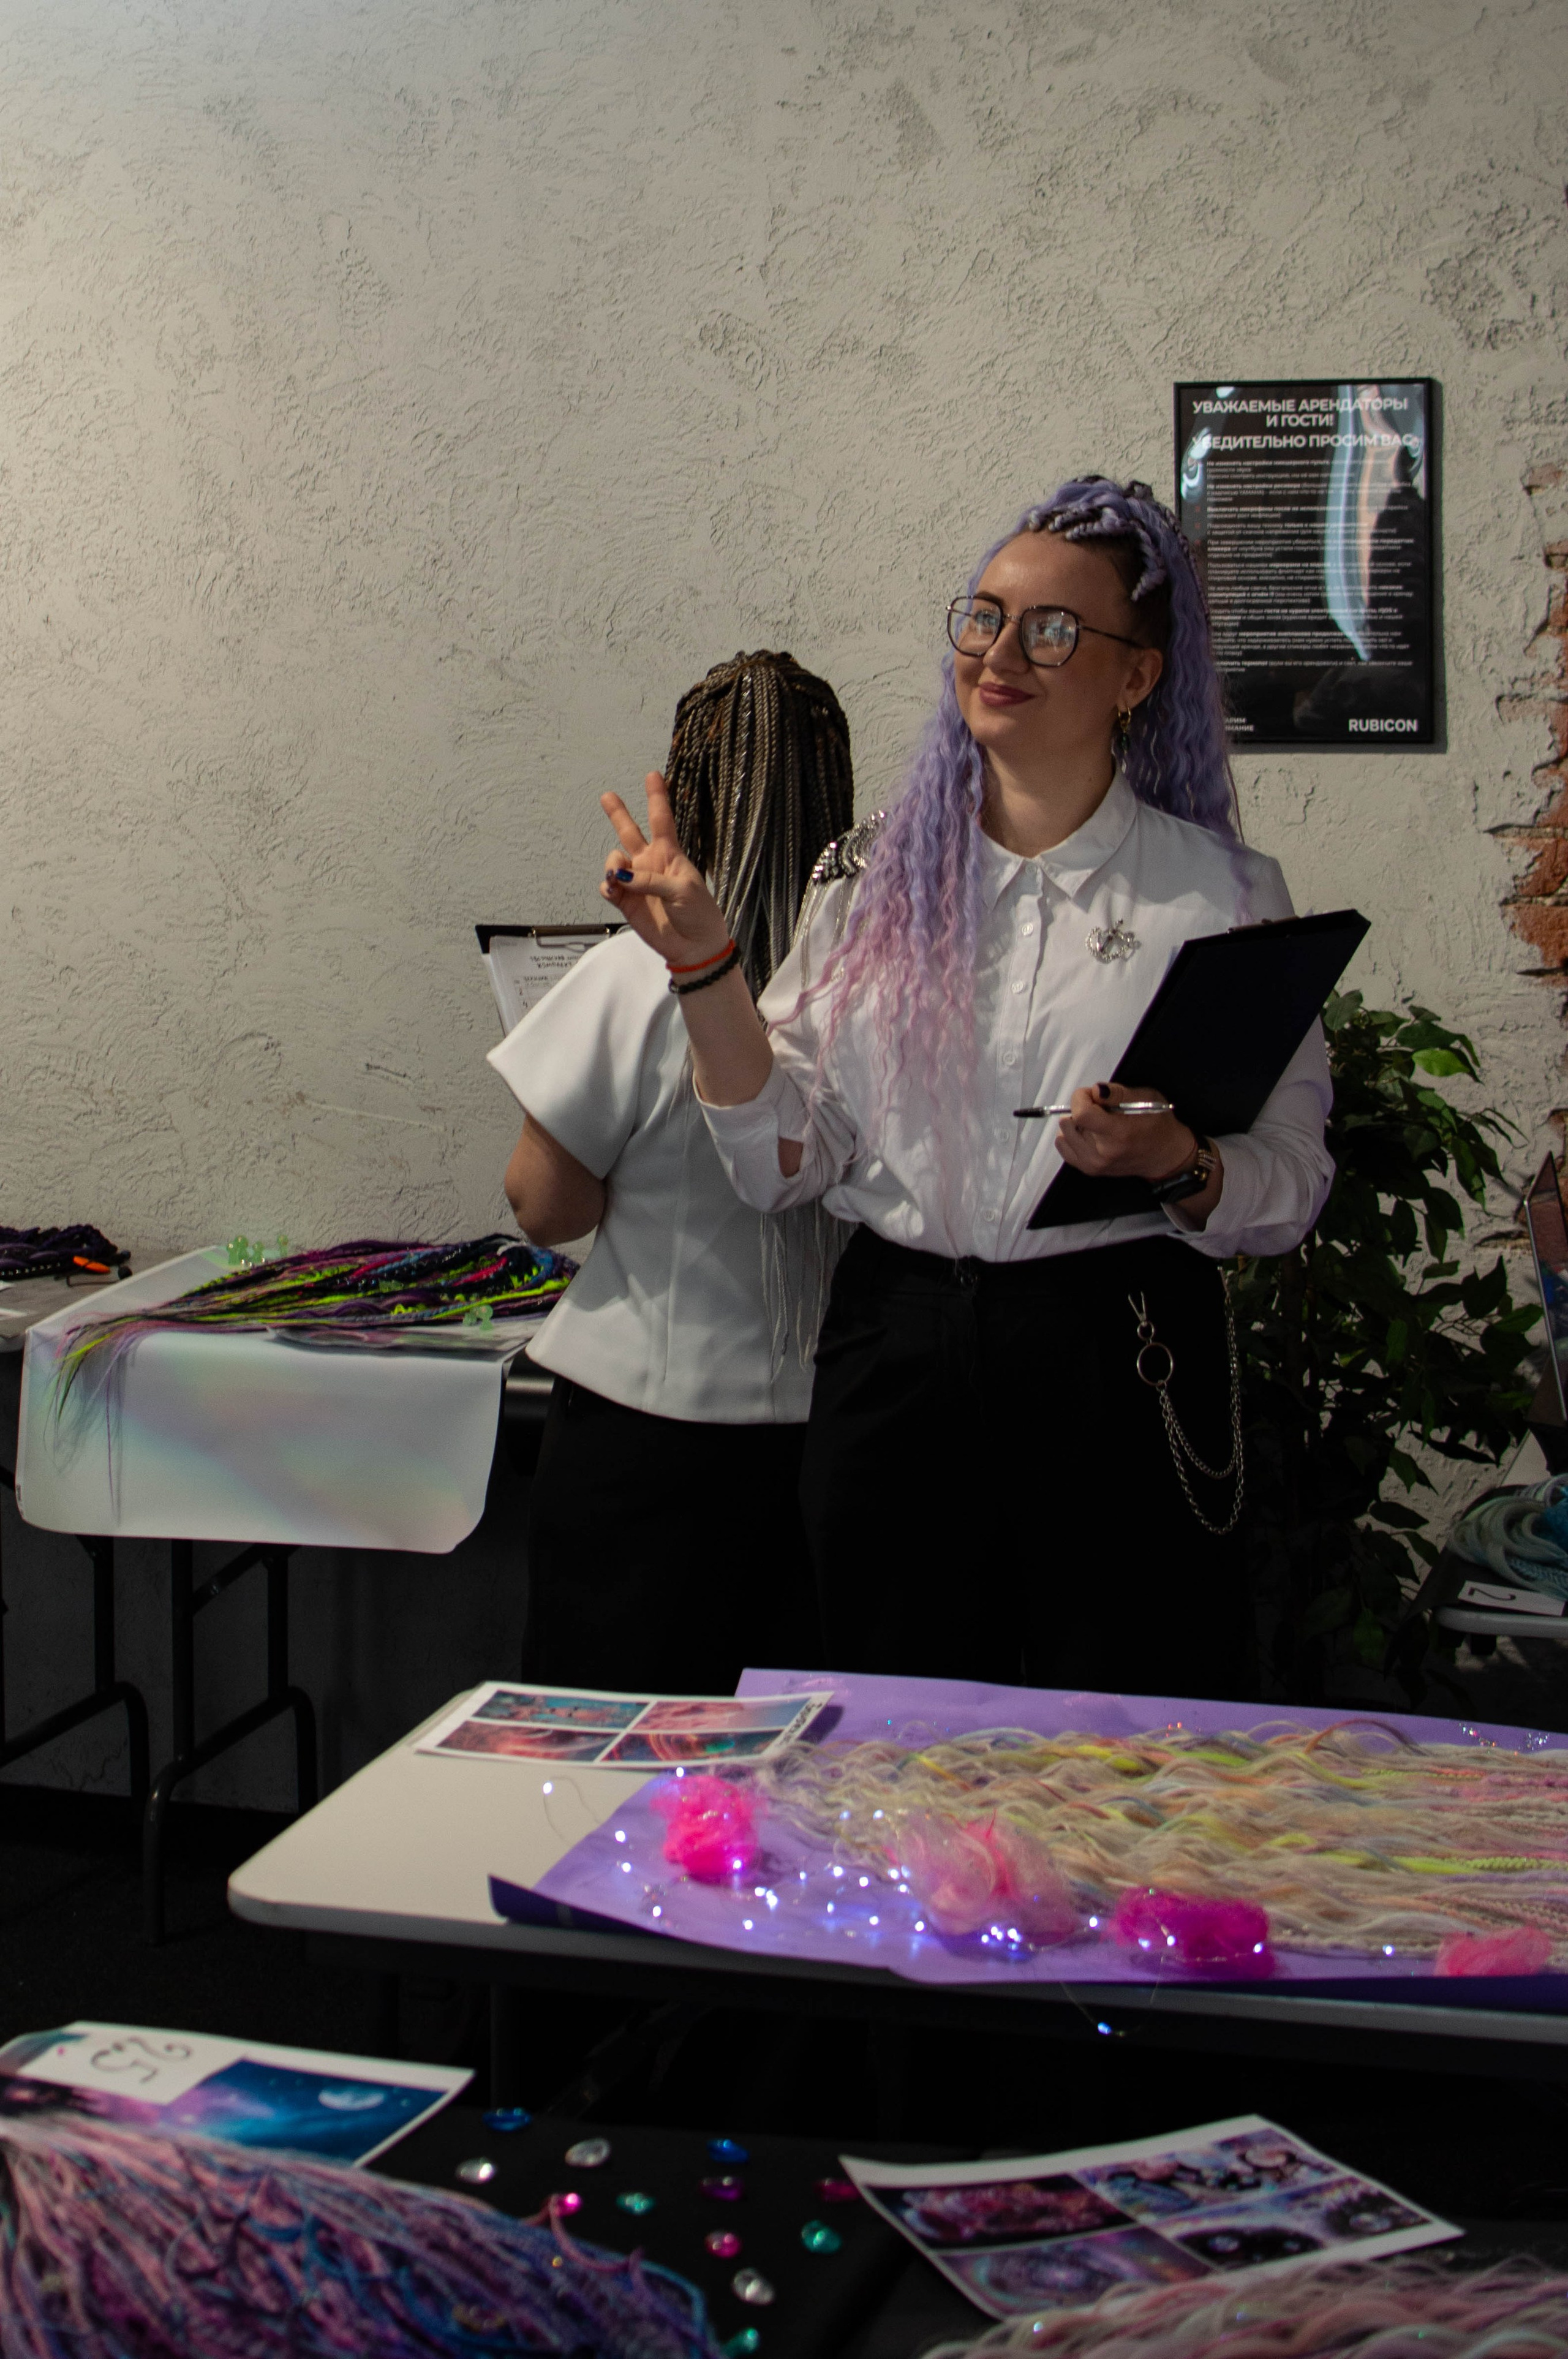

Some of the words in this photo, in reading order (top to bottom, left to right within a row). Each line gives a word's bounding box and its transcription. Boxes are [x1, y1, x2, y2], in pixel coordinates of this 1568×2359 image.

[1193, 399, 1295, 413] УВАЖАЕМЫЕ
[1298, 398, 1408, 413] АРЕНДАТОРЫ
[1266, 414, 1278, 427] И
[1281, 413, 1334, 427] ГОСТИ!
[1309, 434, 1377, 448] ПРОСИМ
[1349, 719, 1418, 732] RUBICON
